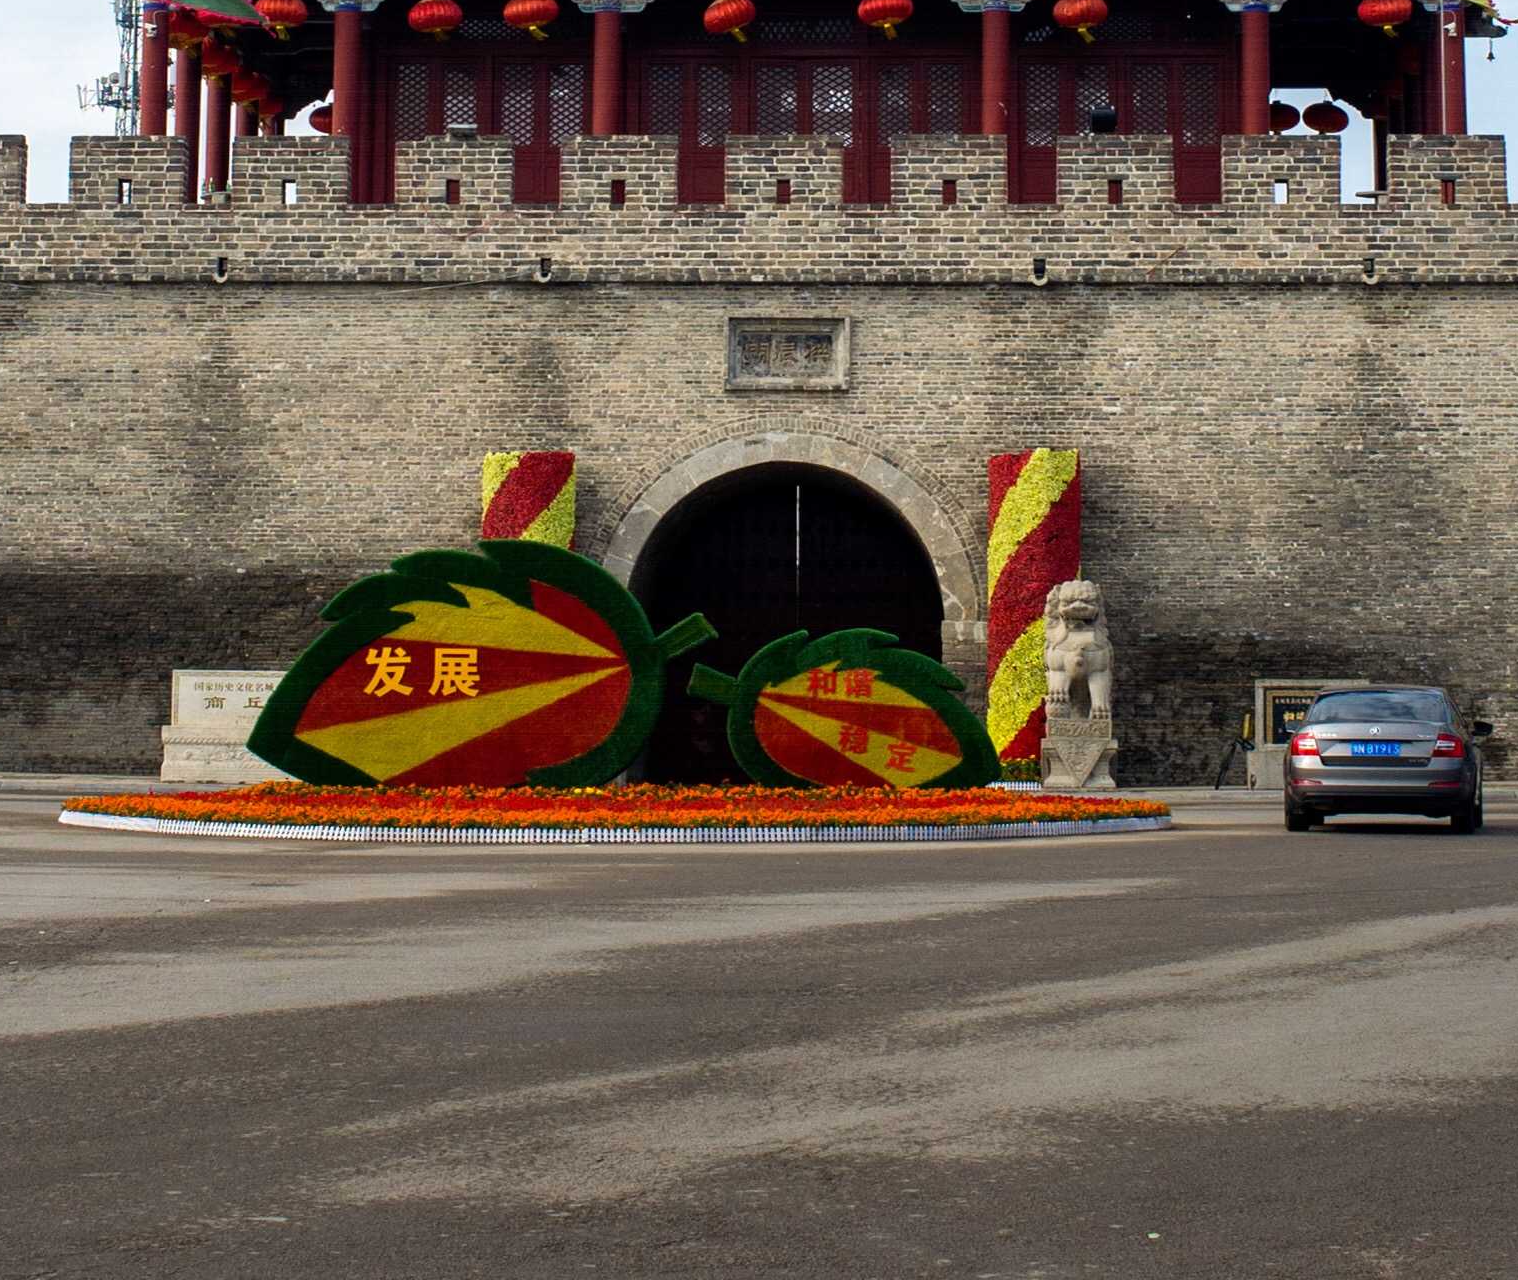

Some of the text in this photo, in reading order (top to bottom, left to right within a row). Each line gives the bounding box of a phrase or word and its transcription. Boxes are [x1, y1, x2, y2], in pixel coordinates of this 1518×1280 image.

[363, 646, 481, 698] 发展
[808, 668, 873, 697] 和谐
[203, 696, 264, 710] 商丘
